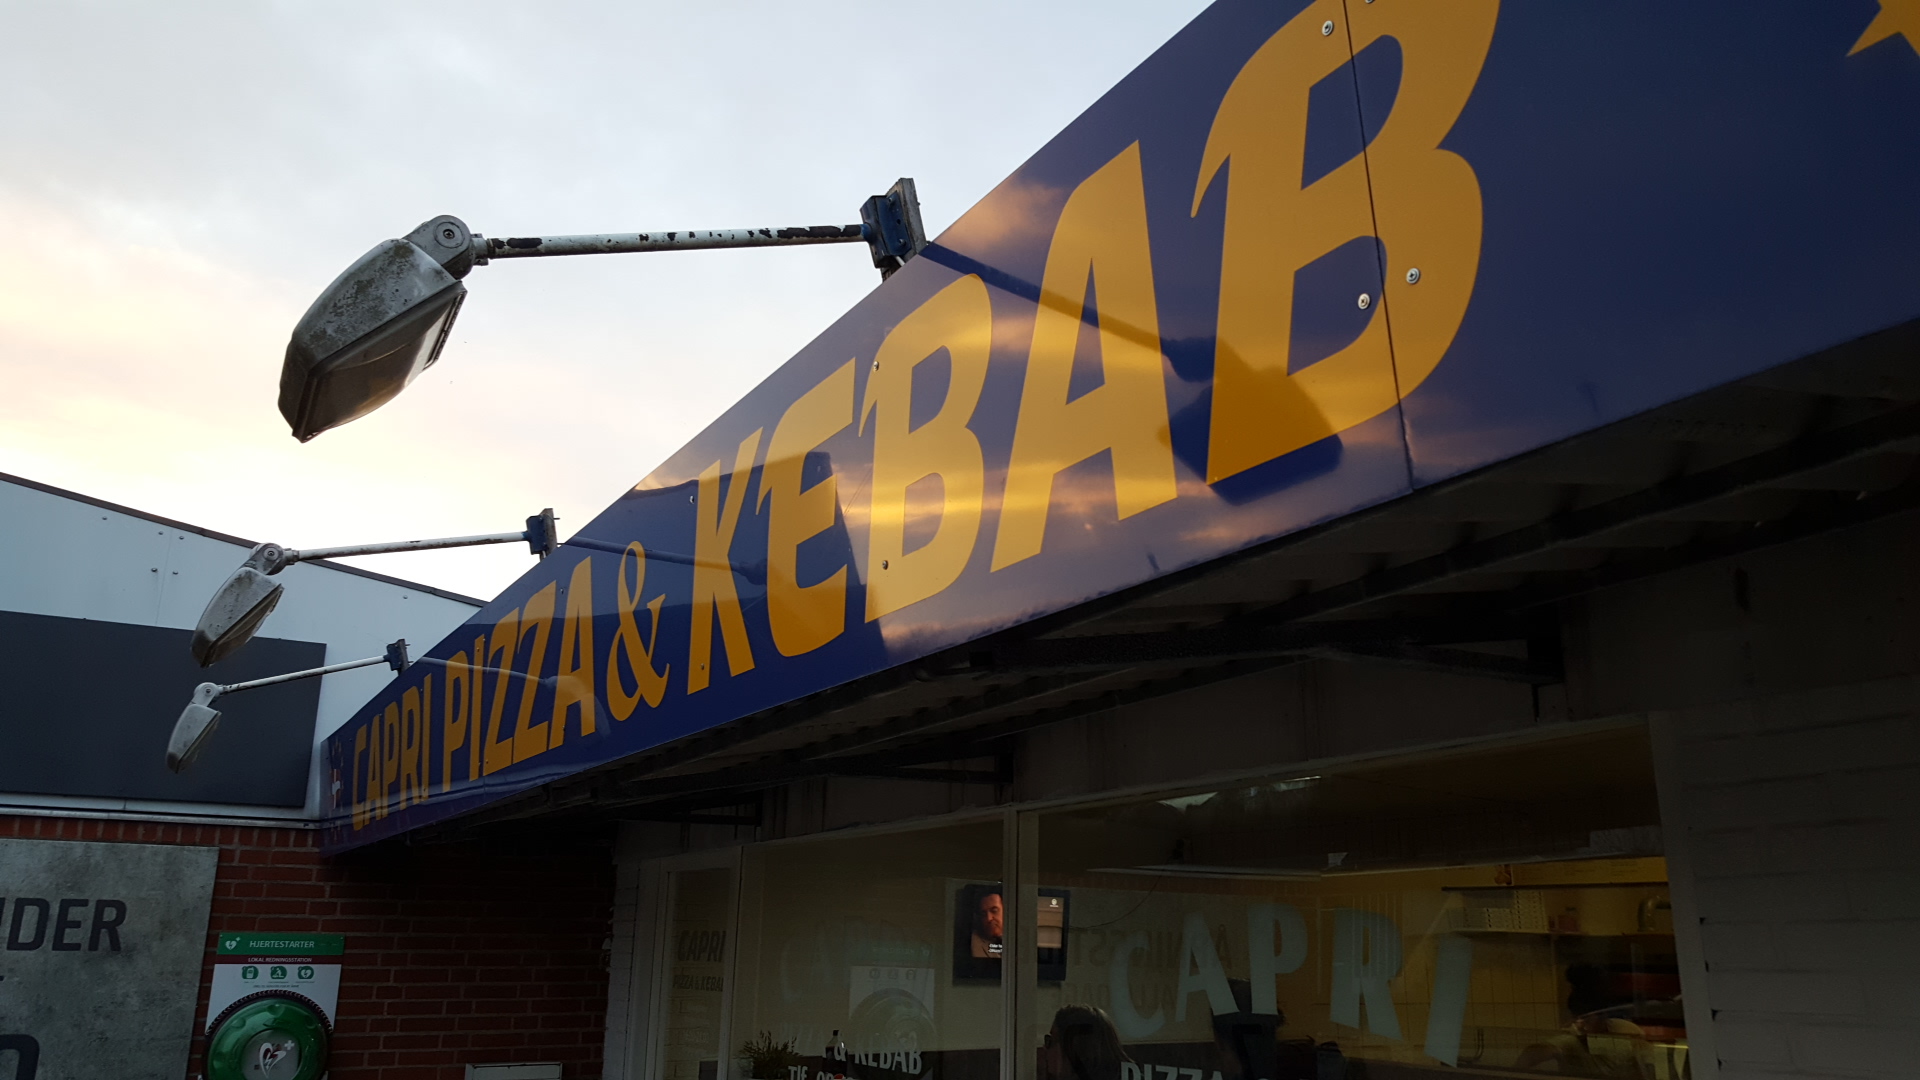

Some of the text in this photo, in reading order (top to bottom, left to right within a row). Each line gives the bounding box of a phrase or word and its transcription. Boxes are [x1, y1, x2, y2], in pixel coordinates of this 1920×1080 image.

[351, 0, 1501, 831] CAPRI PIZZA & KEBAB
[0, 897, 127, 951] DER
[249, 940, 315, 948] HJERTESTARTER
[677, 929, 726, 962] CAPRI
[1110, 901, 1474, 1068] CAPRI
